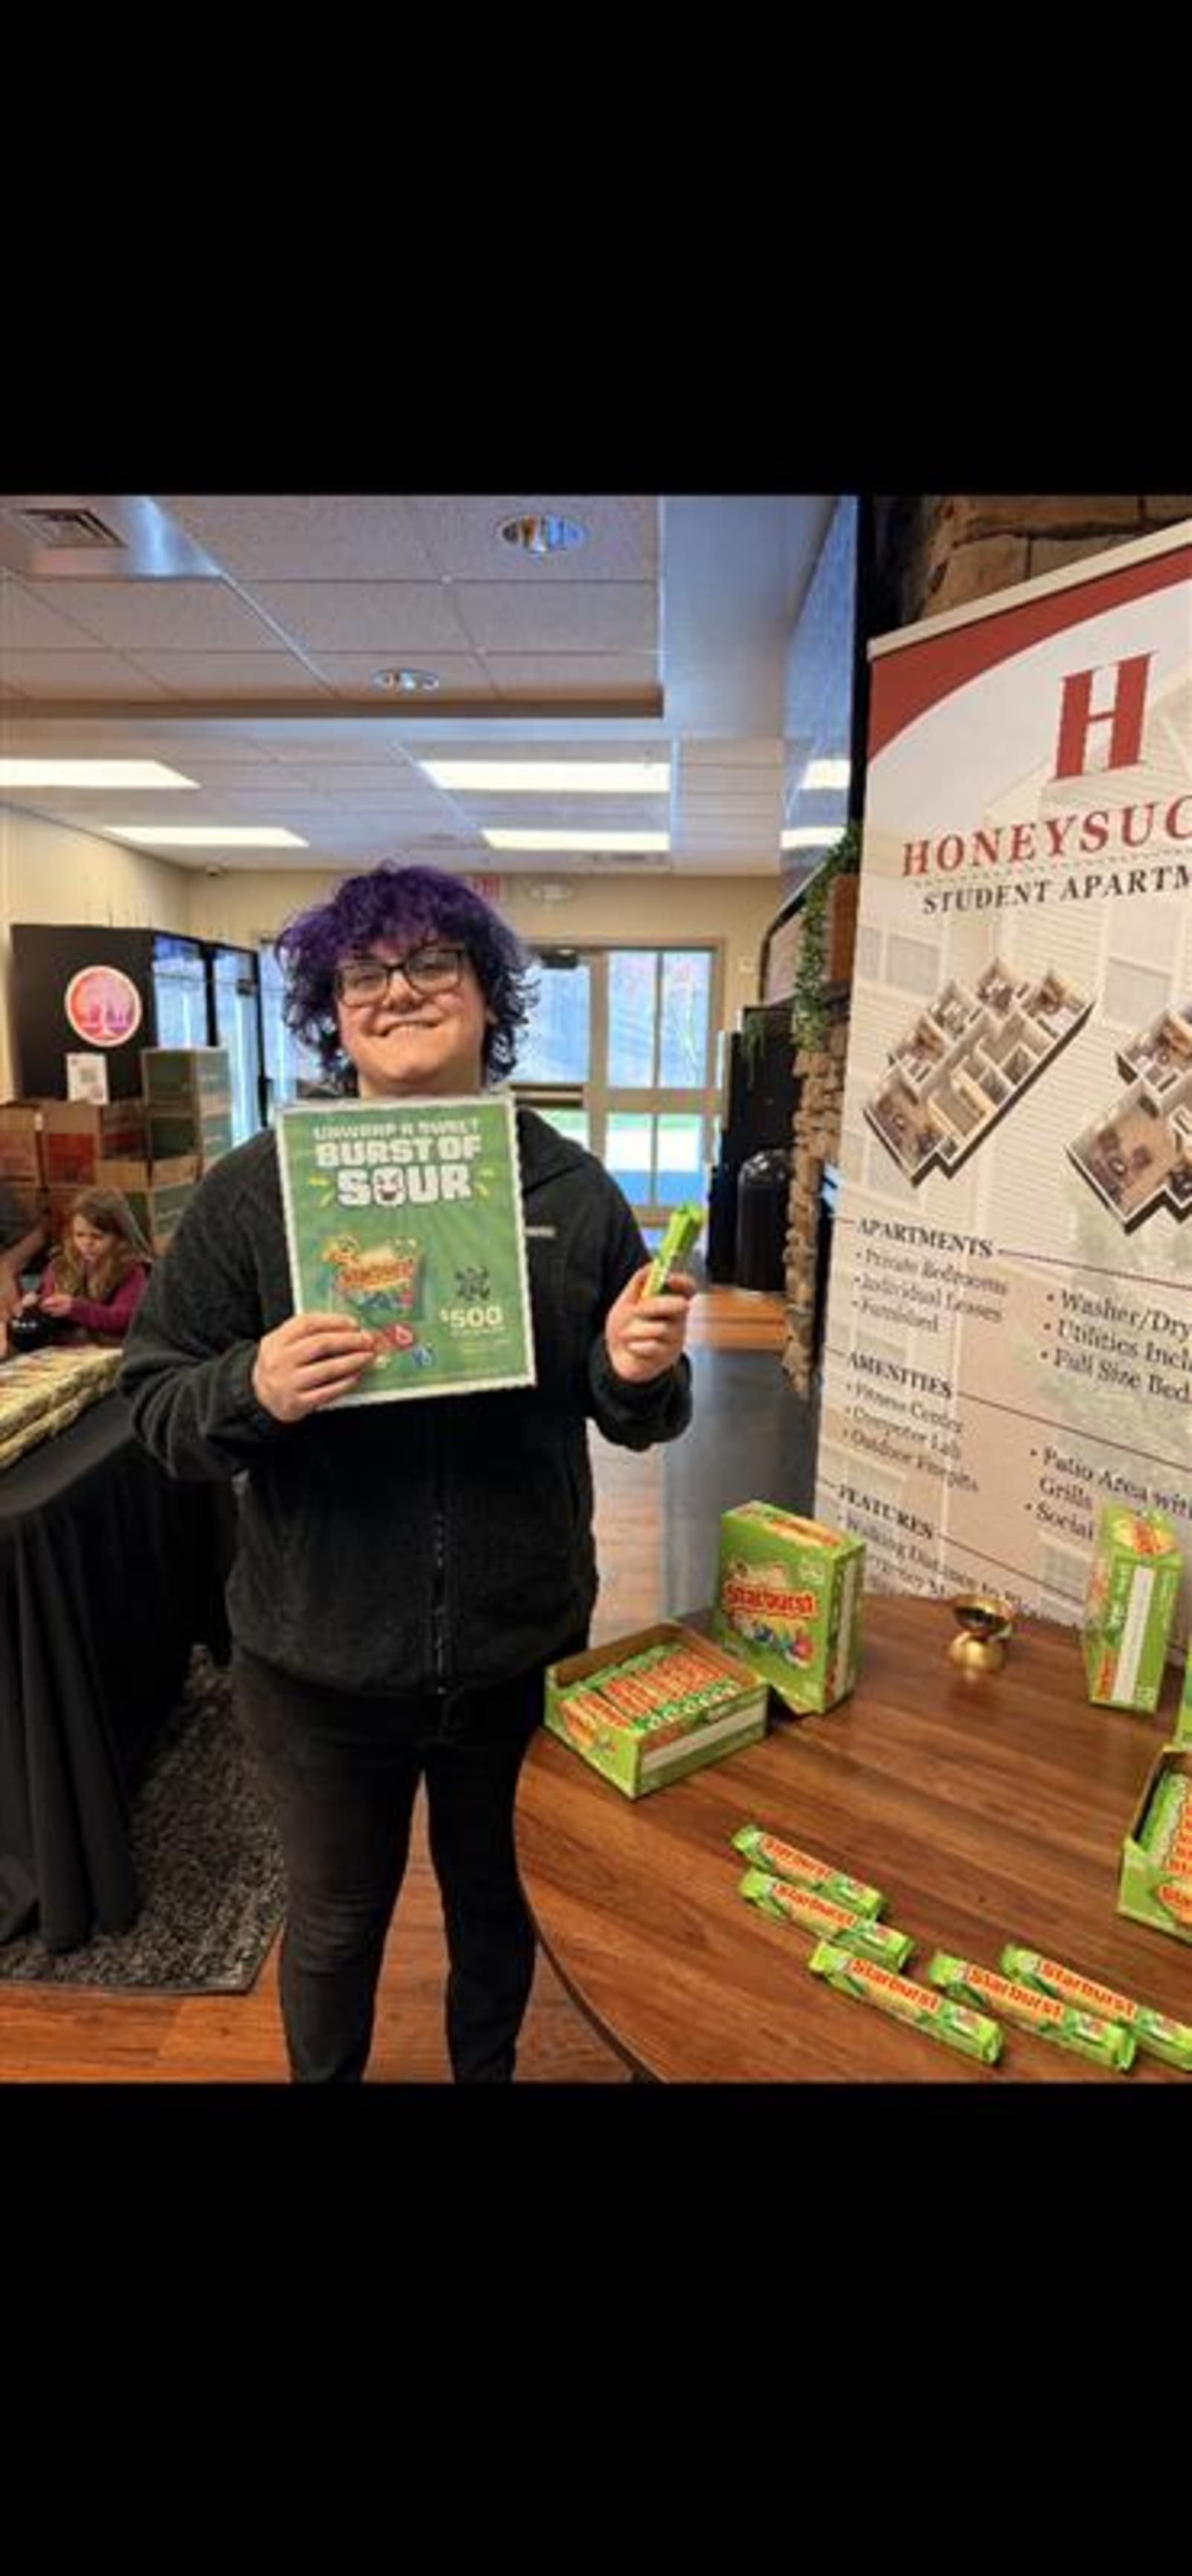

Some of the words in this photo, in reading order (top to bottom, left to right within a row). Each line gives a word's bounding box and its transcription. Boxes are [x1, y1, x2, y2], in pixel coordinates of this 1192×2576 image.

[1047, 651, 1158, 782] H
[901, 795, 1192, 877] HONEYSUC
[922, 881, 1051, 914] STUDENT
[314, 1123, 396, 1139] UNWRAP
[402, 1123, 413, 1133] A
[316, 1136, 434, 1166] BURST
[438, 1135, 481, 1160] OF
[337, 1163, 472, 1206] SOUR
[858, 1219, 993, 1257] APARTMENTS
[866, 1248, 919, 1271] Private
[922, 1261, 1006, 1296] Bedrooms
[440, 1306, 504, 1328] $500
[860, 1300, 938, 1332] Furnished
[861, 1273, 942, 1308] Individual
[946, 1292, 1004, 1323] Leases
[1062, 1288, 1190, 1343] Washer/Dry
[1059, 1319, 1138, 1358] Utilities
[848, 1352, 951, 1399] AMENITIES
[1053, 1347, 1093, 1376] Full
[1097, 1358, 1141, 1388] Size
[857, 1382, 906, 1411] Fitness
[911, 1402, 964, 1434] Center
[851, 1429, 913, 1460] Outdoor
[854, 1406, 927, 1442] Computer
[931, 1434, 961, 1460] Lab
[1040, 1478, 1091, 1510] Grills
[1044, 1446, 1093, 1481] Patio
[1099, 1470, 1147, 1501] Area
[840, 1484, 931, 1539] FEATURES
[1037, 1501, 1094, 1541] Social
[724, 1583, 815, 1617] Starburst
[764, 1834, 833, 1880] Starburst
[773, 1882, 857, 1927] Starburst
[851, 1958, 940, 2013] Starburst
[968, 1964, 1064, 2024] Starburst
[1041, 1959, 1138, 2020] Starburst
